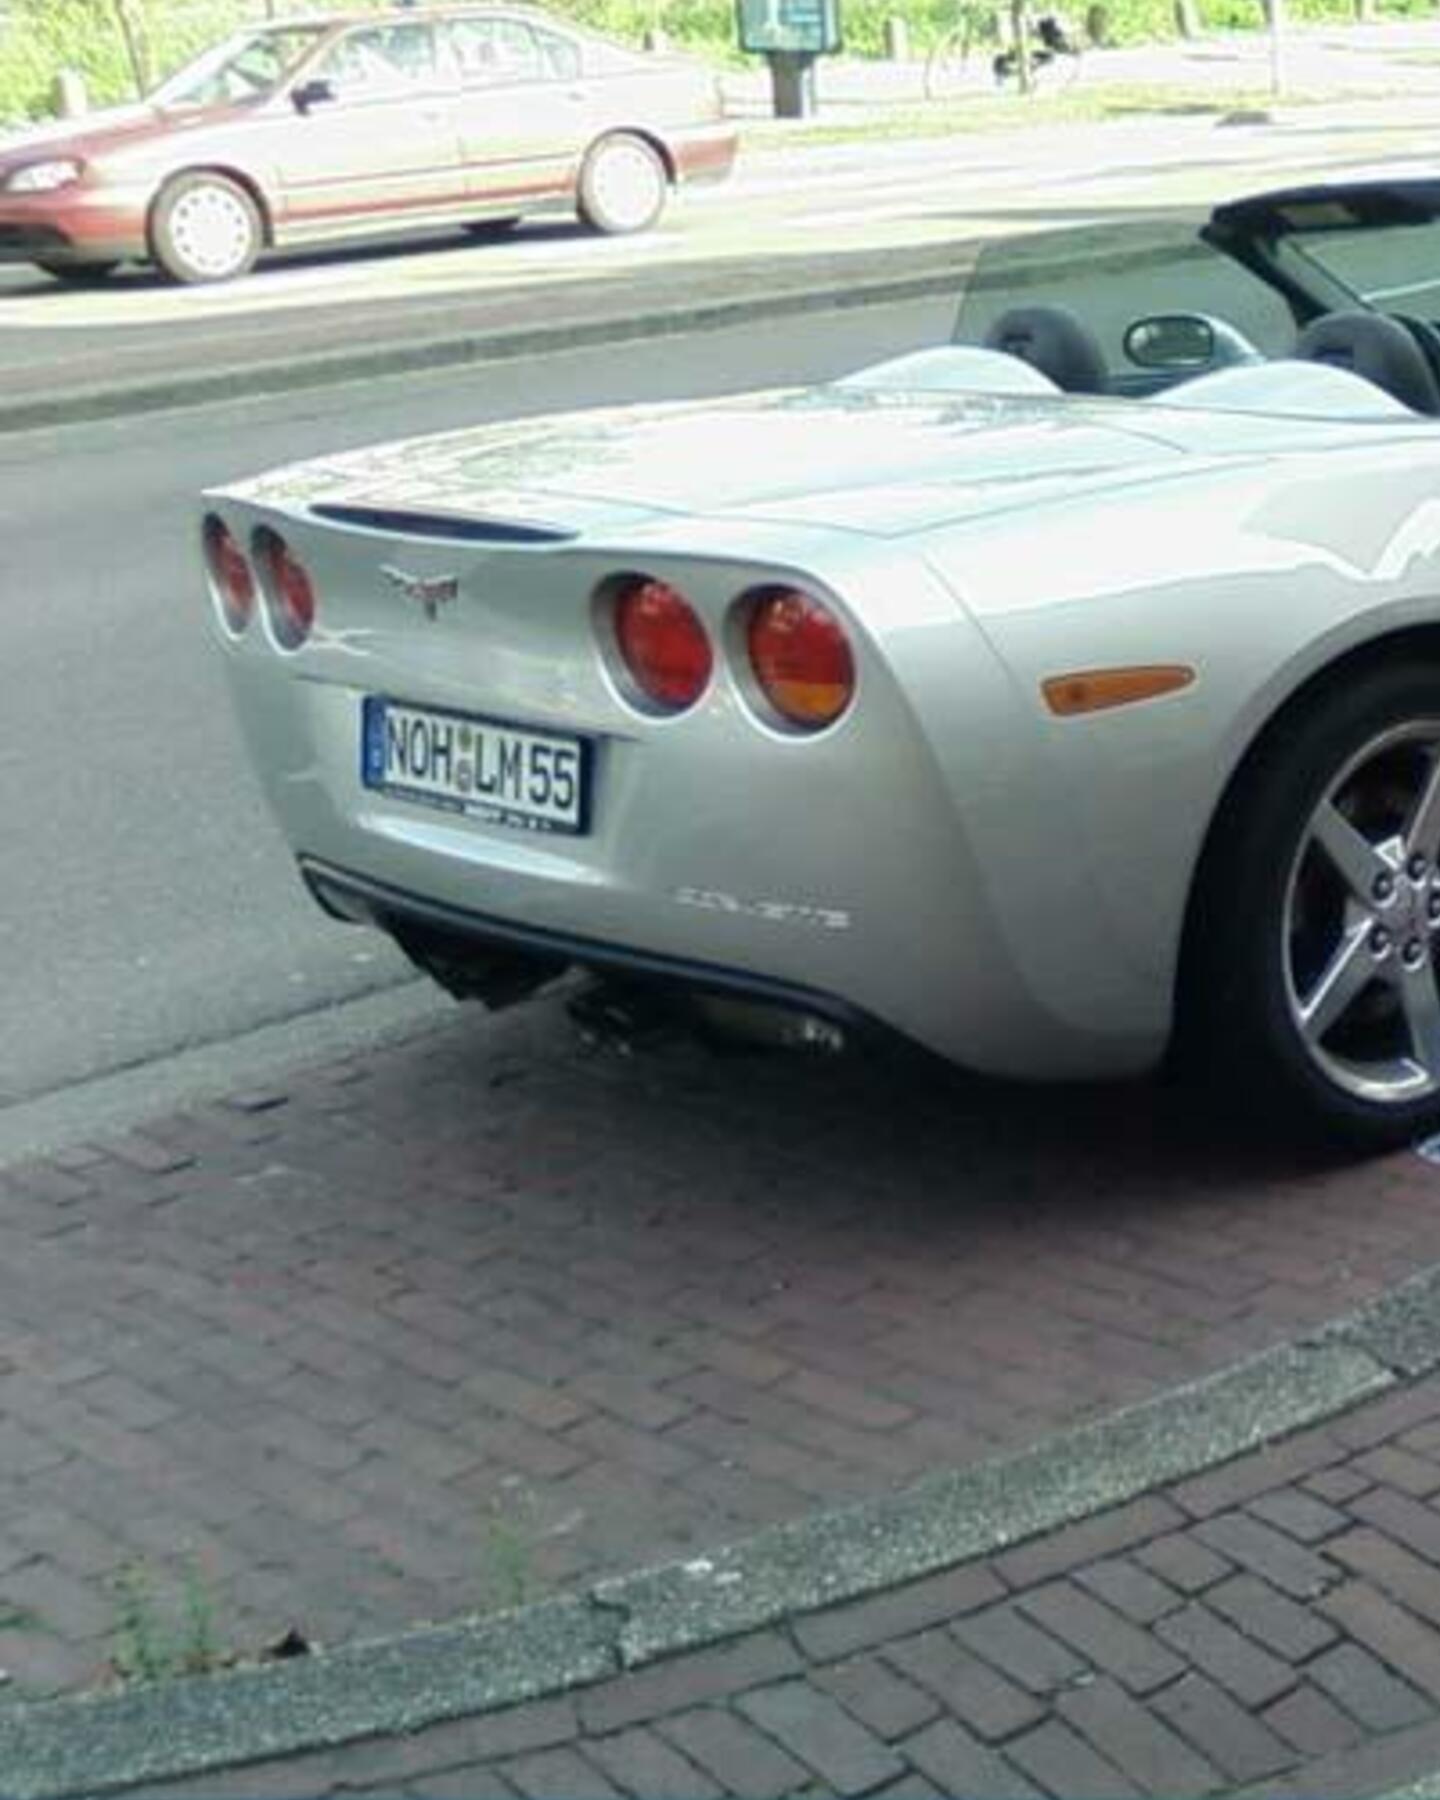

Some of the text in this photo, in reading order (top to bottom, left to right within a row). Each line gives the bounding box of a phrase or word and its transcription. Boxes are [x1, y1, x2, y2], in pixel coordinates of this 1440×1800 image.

[387, 716, 453, 785] NOH
[474, 732, 523, 800] LM
[529, 743, 576, 810] 55
